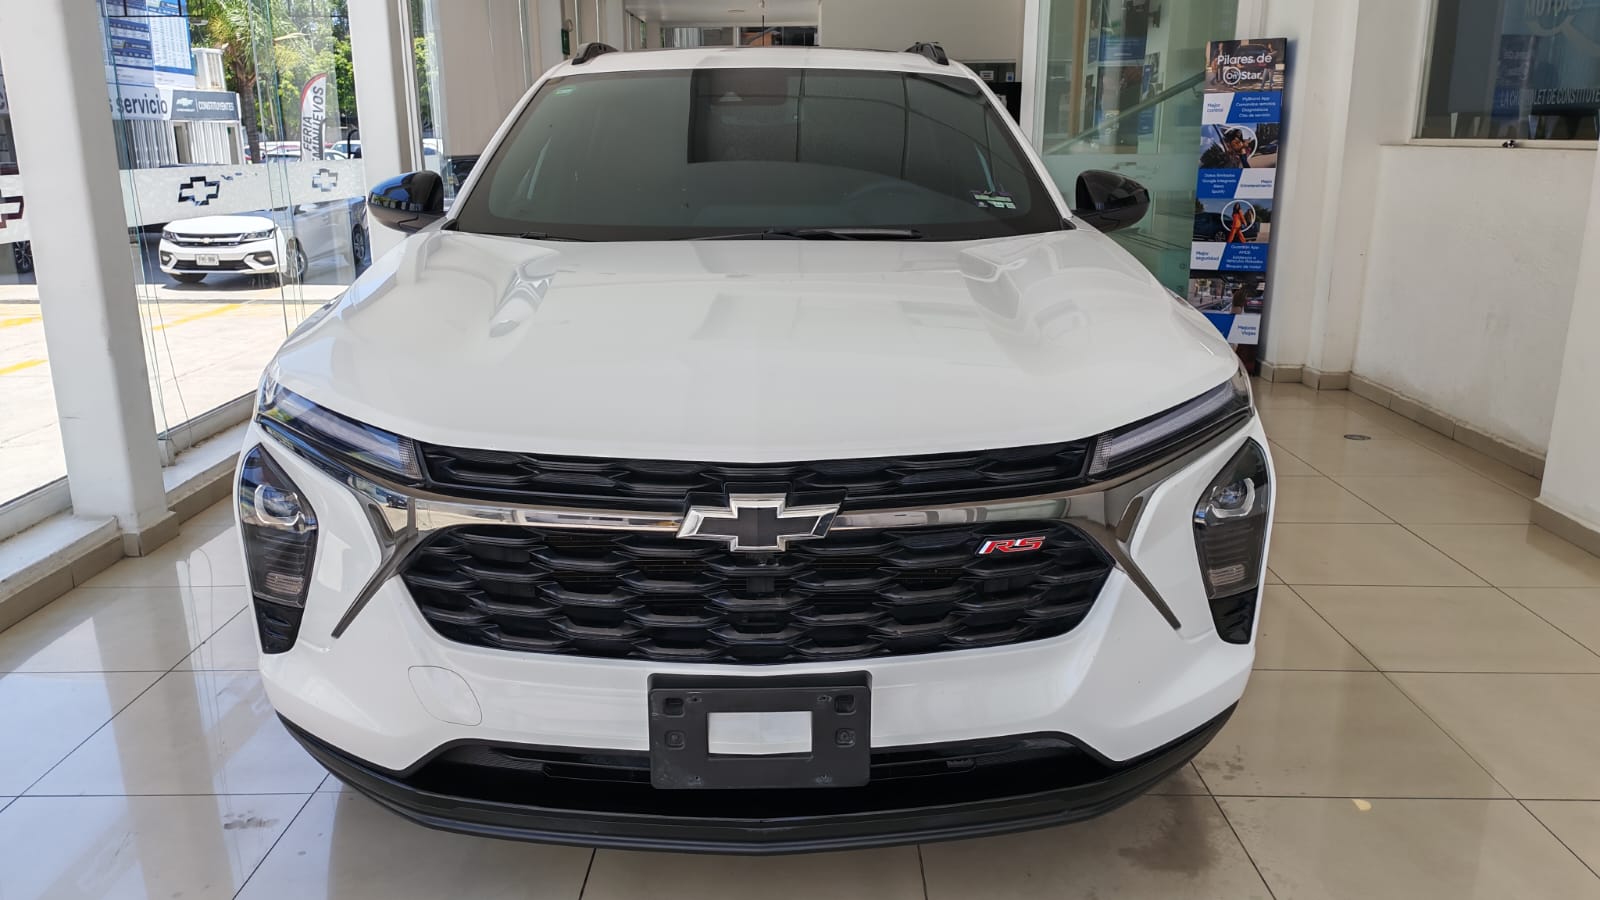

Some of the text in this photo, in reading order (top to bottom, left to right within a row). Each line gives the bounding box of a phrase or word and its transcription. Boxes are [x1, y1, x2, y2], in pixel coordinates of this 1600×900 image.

[1217, 52, 1273, 65] Pilares de
[117, 93, 168, 115] servicio
[303, 116, 312, 152] FERIA
[312, 86, 324, 160] MINUEVOS
[978, 536, 1046, 555] RS
